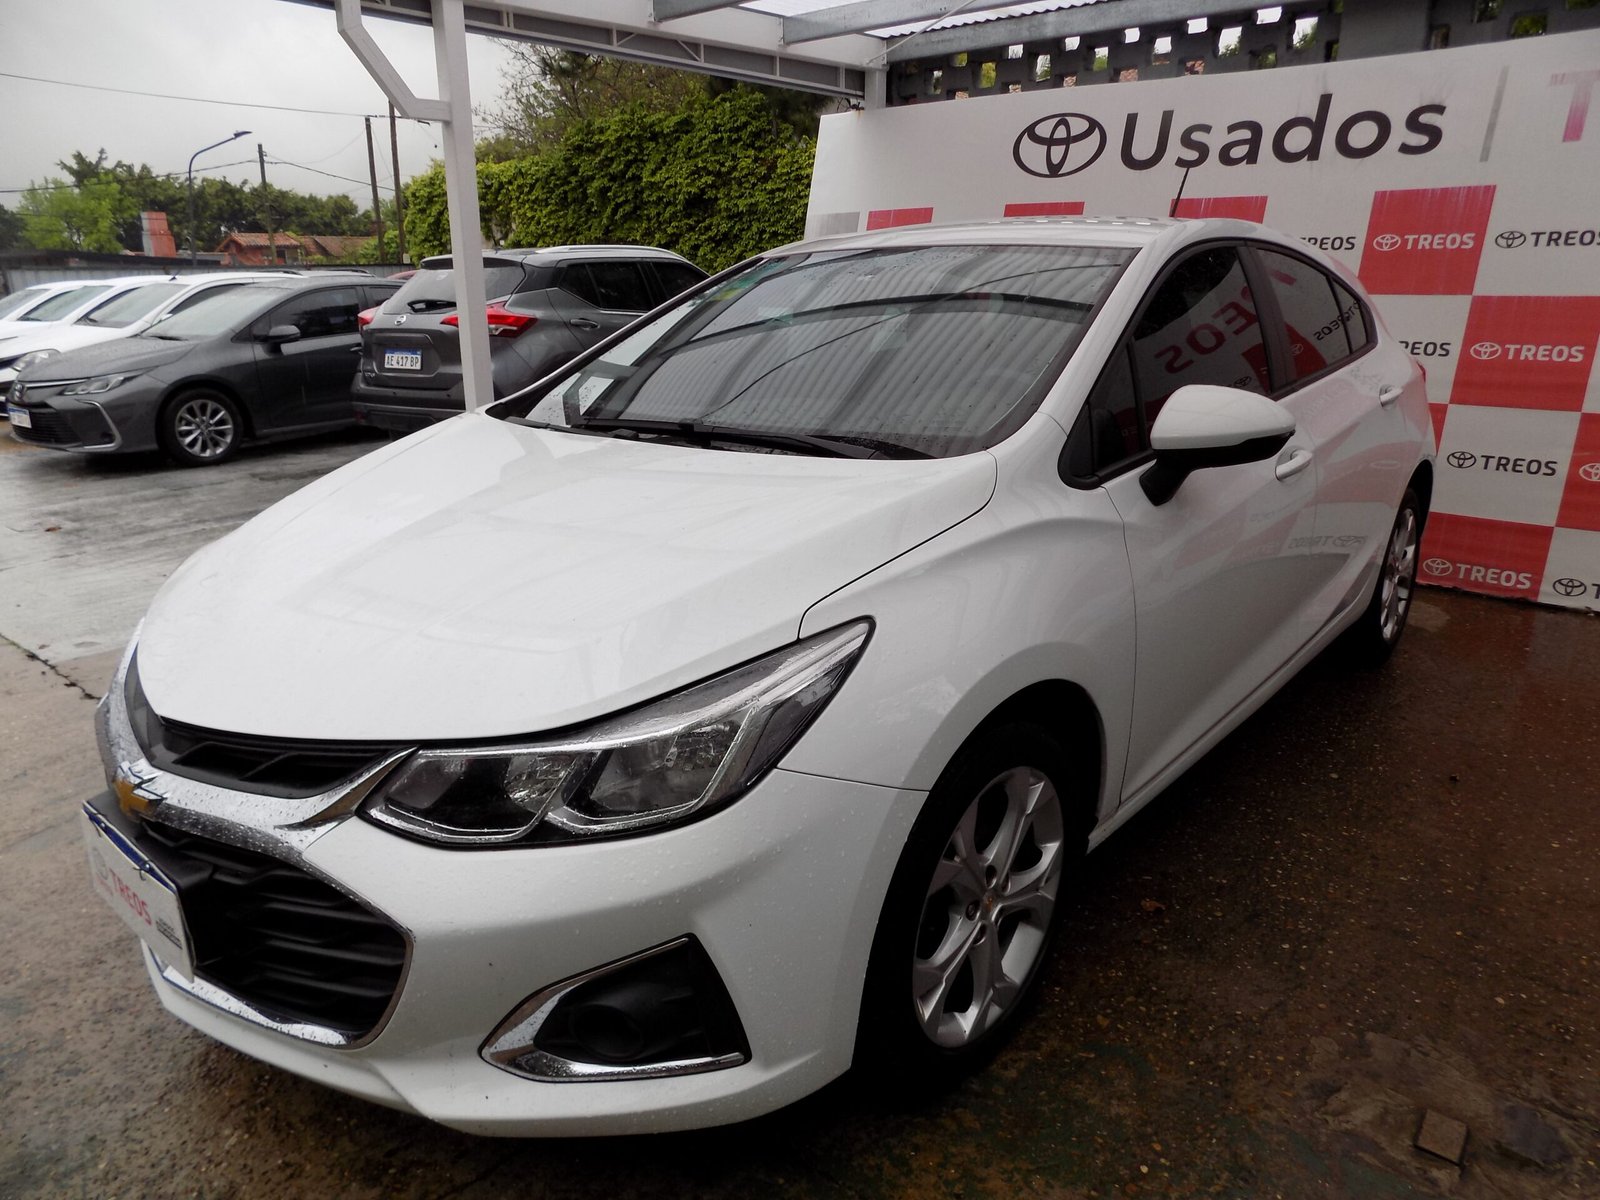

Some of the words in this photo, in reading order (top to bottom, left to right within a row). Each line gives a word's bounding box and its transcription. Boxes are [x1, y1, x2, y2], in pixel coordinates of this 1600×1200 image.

[1120, 93, 1447, 171] Usados
[1300, 236, 1356, 251] REOS
[1403, 232, 1475, 250] TREOS
[386, 355, 395, 367] AE
[396, 355, 409, 367] 417
[410, 356, 419, 367] BP
[1505, 344, 1585, 362] TREOS
[1481, 454, 1558, 477] TREOS
[1456, 562, 1532, 590] TREOS
